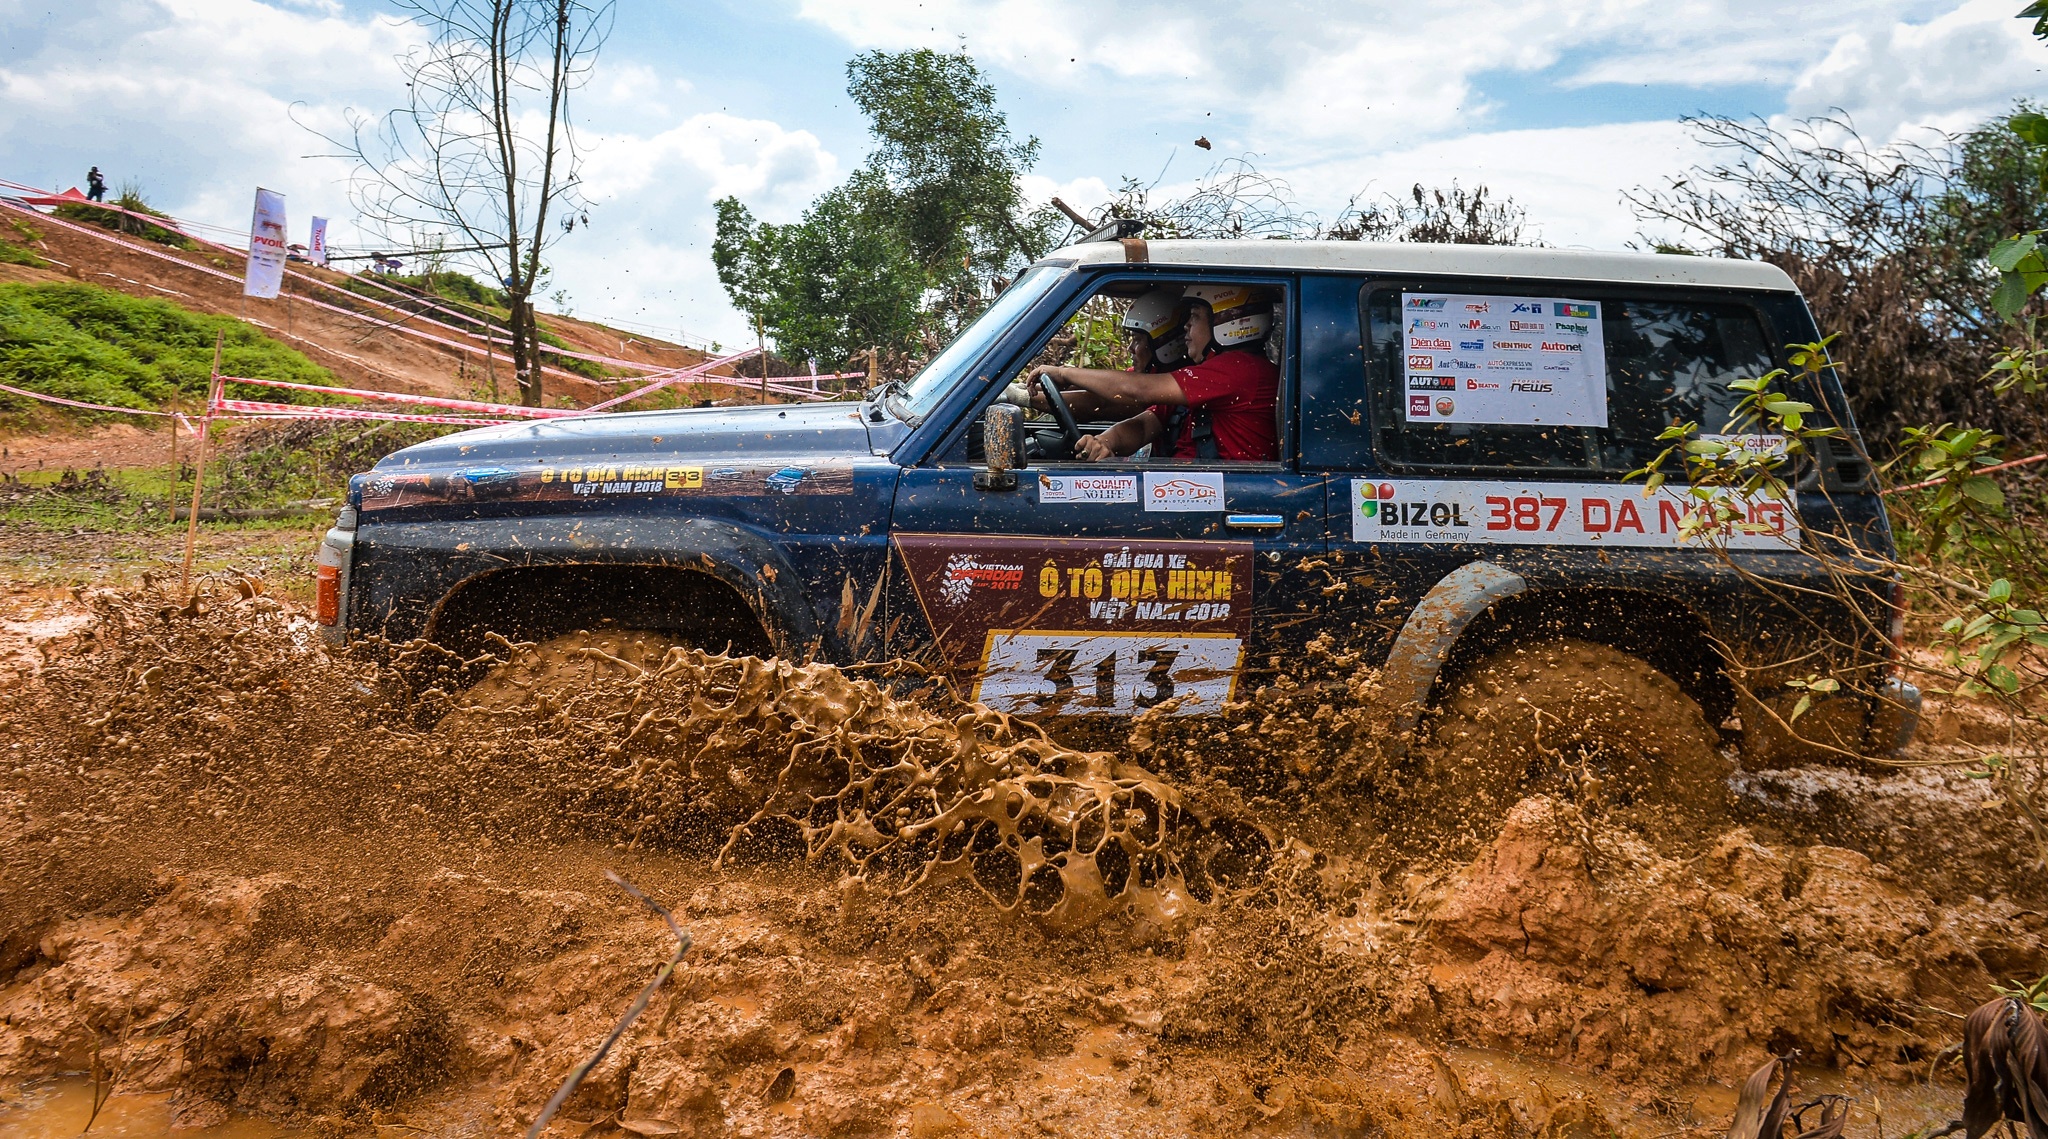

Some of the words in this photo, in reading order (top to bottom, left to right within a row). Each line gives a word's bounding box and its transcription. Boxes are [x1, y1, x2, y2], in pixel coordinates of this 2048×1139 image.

[254, 236, 285, 249] PVOIL
[1213, 290, 1235, 300] PVOIL
[1150, 315, 1168, 327] PVOIL
[1541, 342, 1583, 352] Autonet
[668, 471, 700, 481] 313
[573, 481, 598, 496] VIỆT
[602, 481, 631, 493] NAM
[634, 481, 663, 493] 2018
[1074, 479, 1090, 490] NO
[1092, 479, 1133, 490] QUALITY
[1083, 490, 1099, 499] NO
[1100, 489, 1125, 499] LIFE
[1380, 502, 1469, 527] BIZOL
[1485, 495, 1566, 531] 387
[1582, 498, 1645, 533] DA
[1380, 529, 1409, 540] Made
[1411, 529, 1420, 539] in
[1425, 529, 1470, 541] Germany
[1167, 554, 1187, 569] XE
[951, 569, 1024, 581] OFFROAD
[1039, 558, 1059, 598] Ô
[1067, 559, 1103, 599] TÔ
[990, 582, 1020, 590] 2018
[1089, 598, 1130, 624] VIỆT
[1185, 603, 1231, 621] 2018
